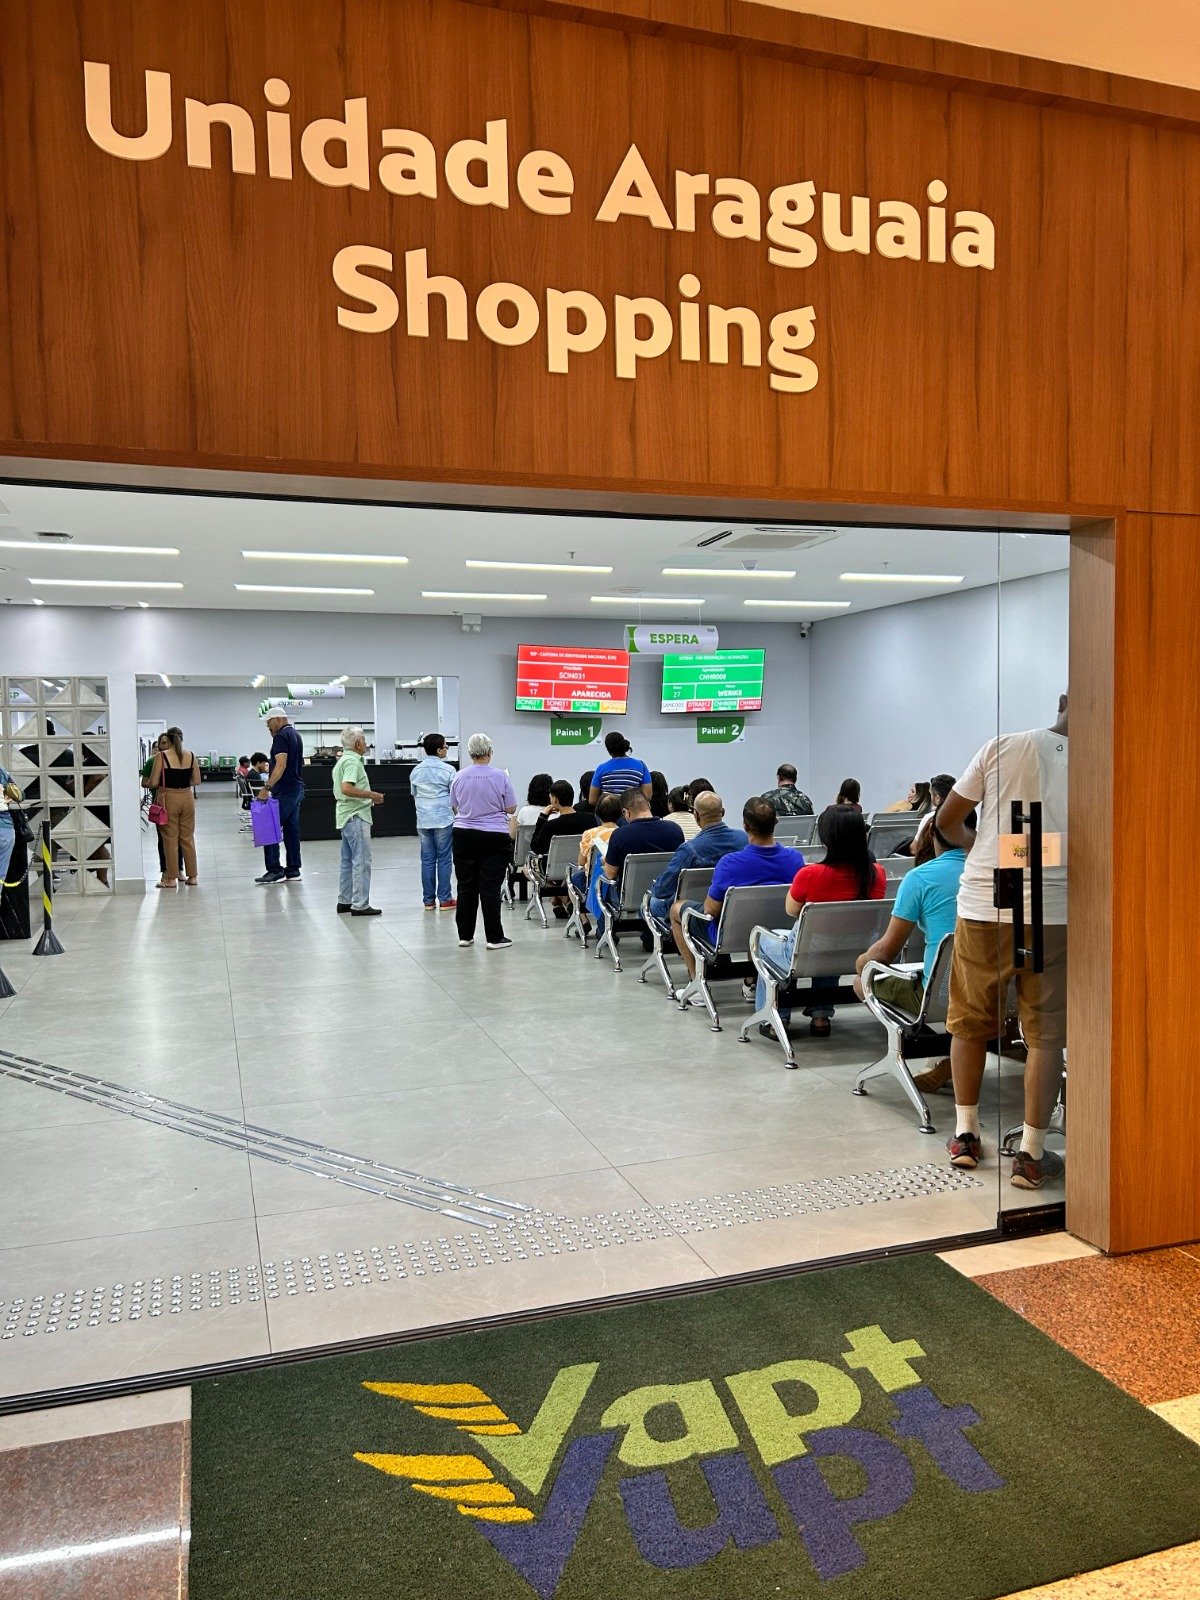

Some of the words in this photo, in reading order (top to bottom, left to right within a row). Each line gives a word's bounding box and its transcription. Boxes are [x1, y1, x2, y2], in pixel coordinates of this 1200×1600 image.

[83, 60, 576, 216] Unidade
[595, 143, 997, 270] Araguaia
[331, 244, 819, 393] Shopping
[649, 633, 699, 645] ESPERA
[559, 672, 586, 680] SCIN031
[309, 688, 326, 696] SSP
[529, 688, 538, 696] 17
[571, 690, 612, 699] APARECIDA
[555, 728, 582, 736] Painel
[588, 726, 594, 738] 1
[702, 726, 726, 735] Painel
[731, 724, 740, 736] 2
[470, 1325, 926, 1495] Vapt
[474, 1386, 1007, 1600] Vupt
